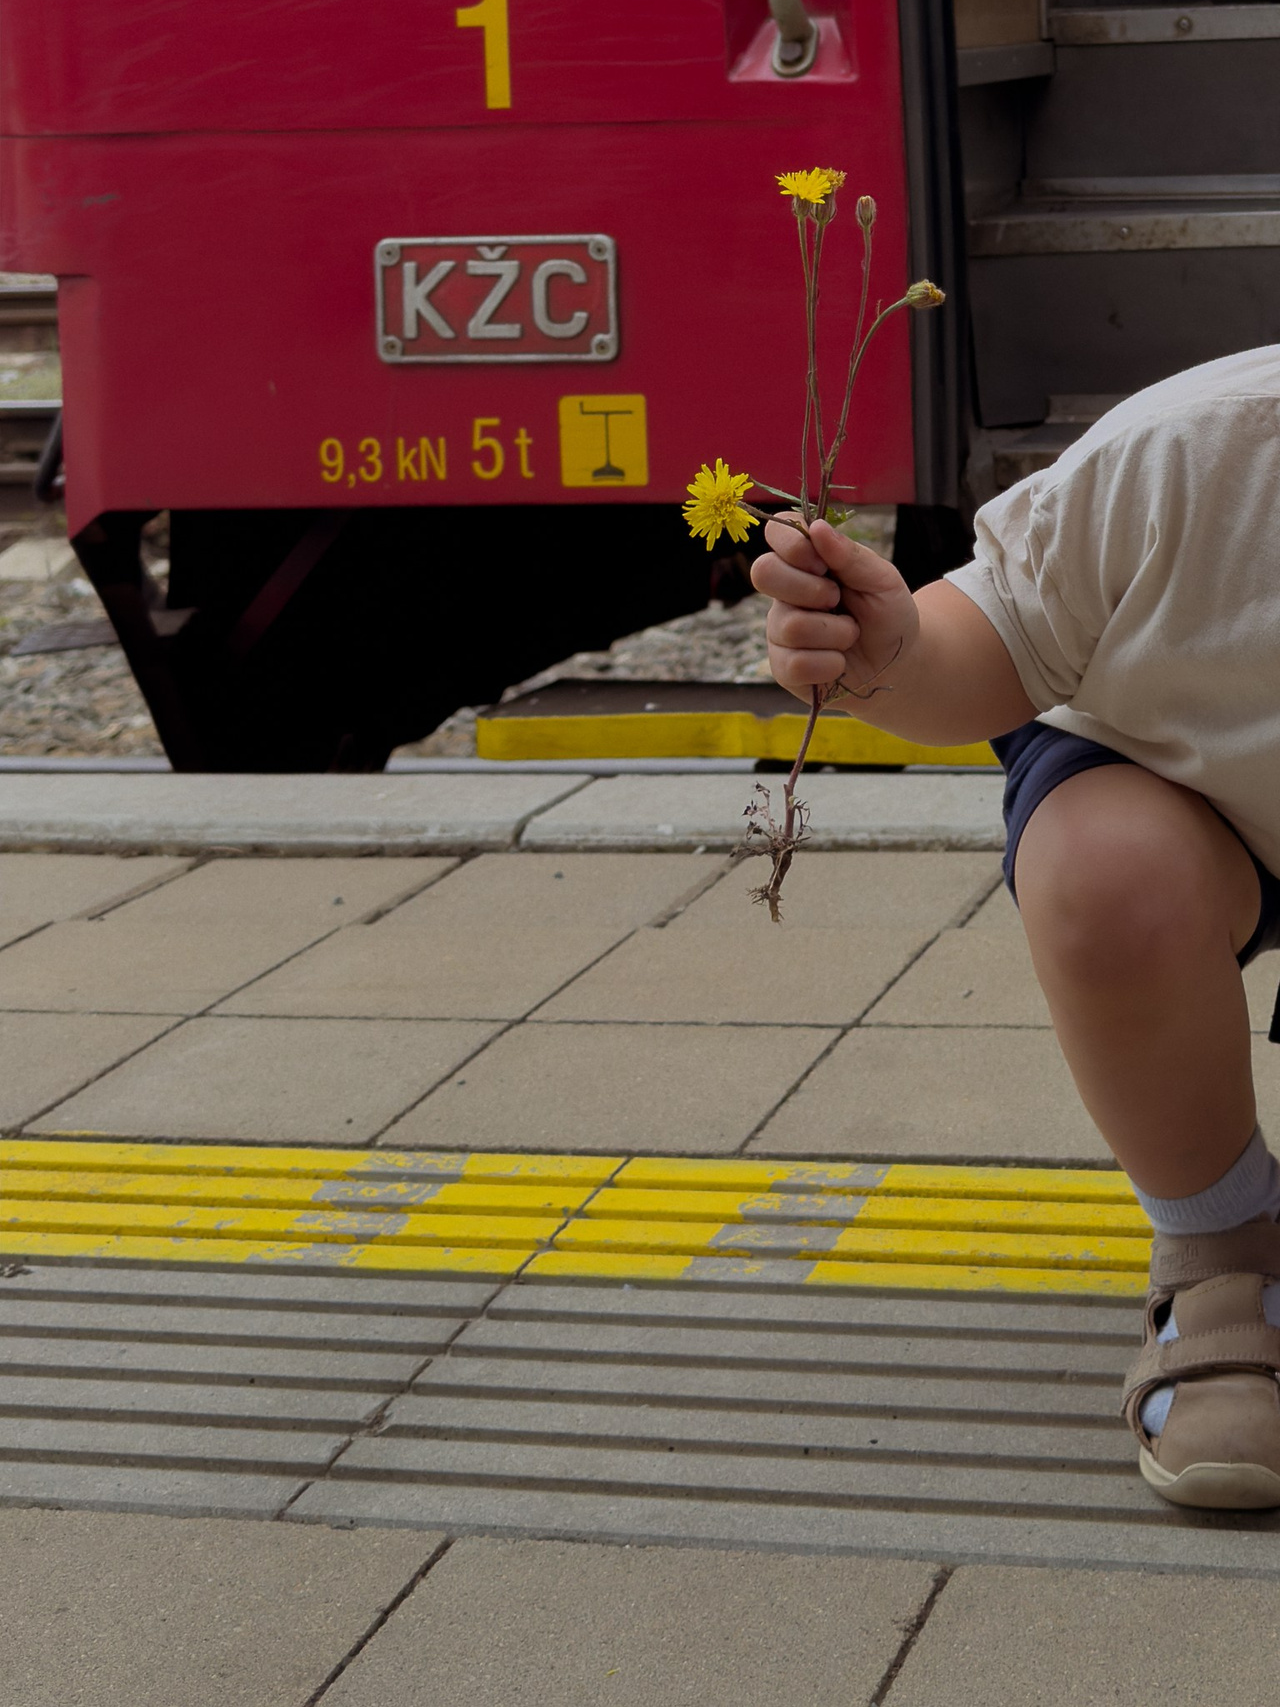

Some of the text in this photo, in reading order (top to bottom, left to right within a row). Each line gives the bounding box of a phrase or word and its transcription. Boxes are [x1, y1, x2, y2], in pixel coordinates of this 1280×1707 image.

[402, 245, 589, 340] KŽC
[318, 416, 536, 488] 9,3 kN 5 t
